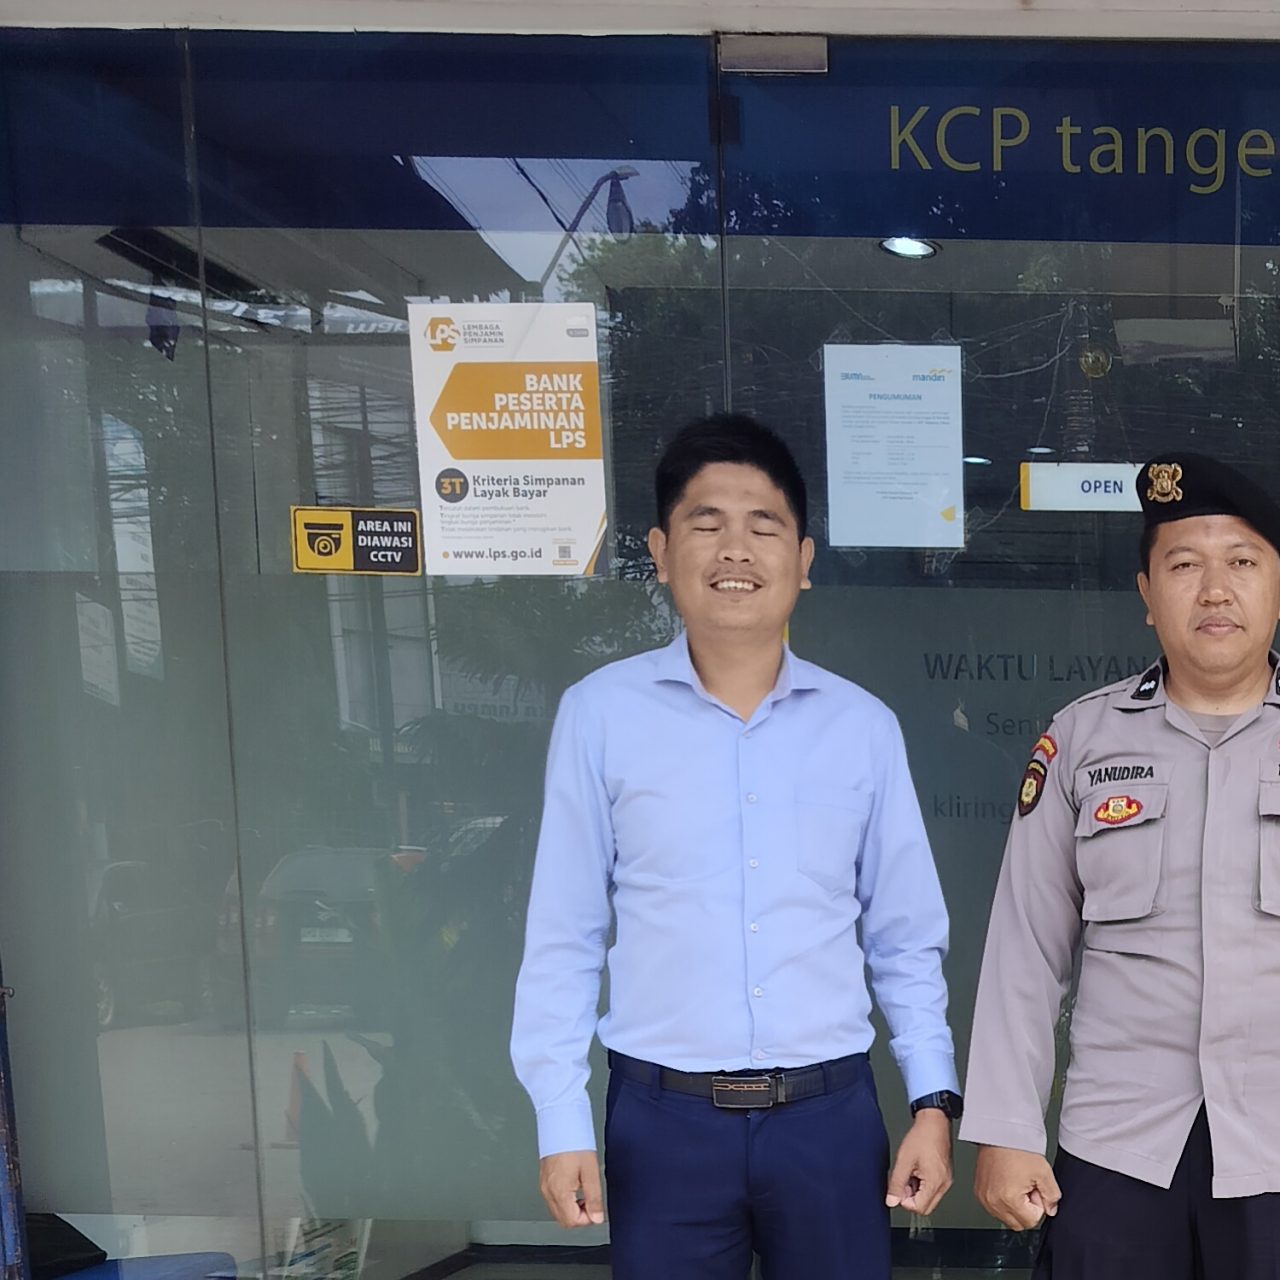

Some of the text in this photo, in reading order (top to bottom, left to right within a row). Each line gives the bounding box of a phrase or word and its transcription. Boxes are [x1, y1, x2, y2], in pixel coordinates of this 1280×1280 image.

[890, 104, 1031, 172] KCP
[426, 323, 460, 345] LPS
[525, 373, 583, 391] BANK
[494, 393, 585, 411] PESERTA
[446, 412, 585, 430] PENJAMINAN
[550, 431, 586, 448] LPS
[440, 478, 464, 495] 3T
[472, 475, 586, 488] Kriteria Simpanan
[1080, 480, 1124, 494] OPEN
[473, 487, 548, 500] Layak Bayar
[357, 520, 412, 533] AREA INI
[358, 535, 412, 548] DIAWASI
[369, 551, 402, 563] CCTV
[453, 547, 543, 561] www.lps.go.id
[923, 653, 1036, 681] WAKTU
[1088, 766, 1155, 787] YANUDIRA
